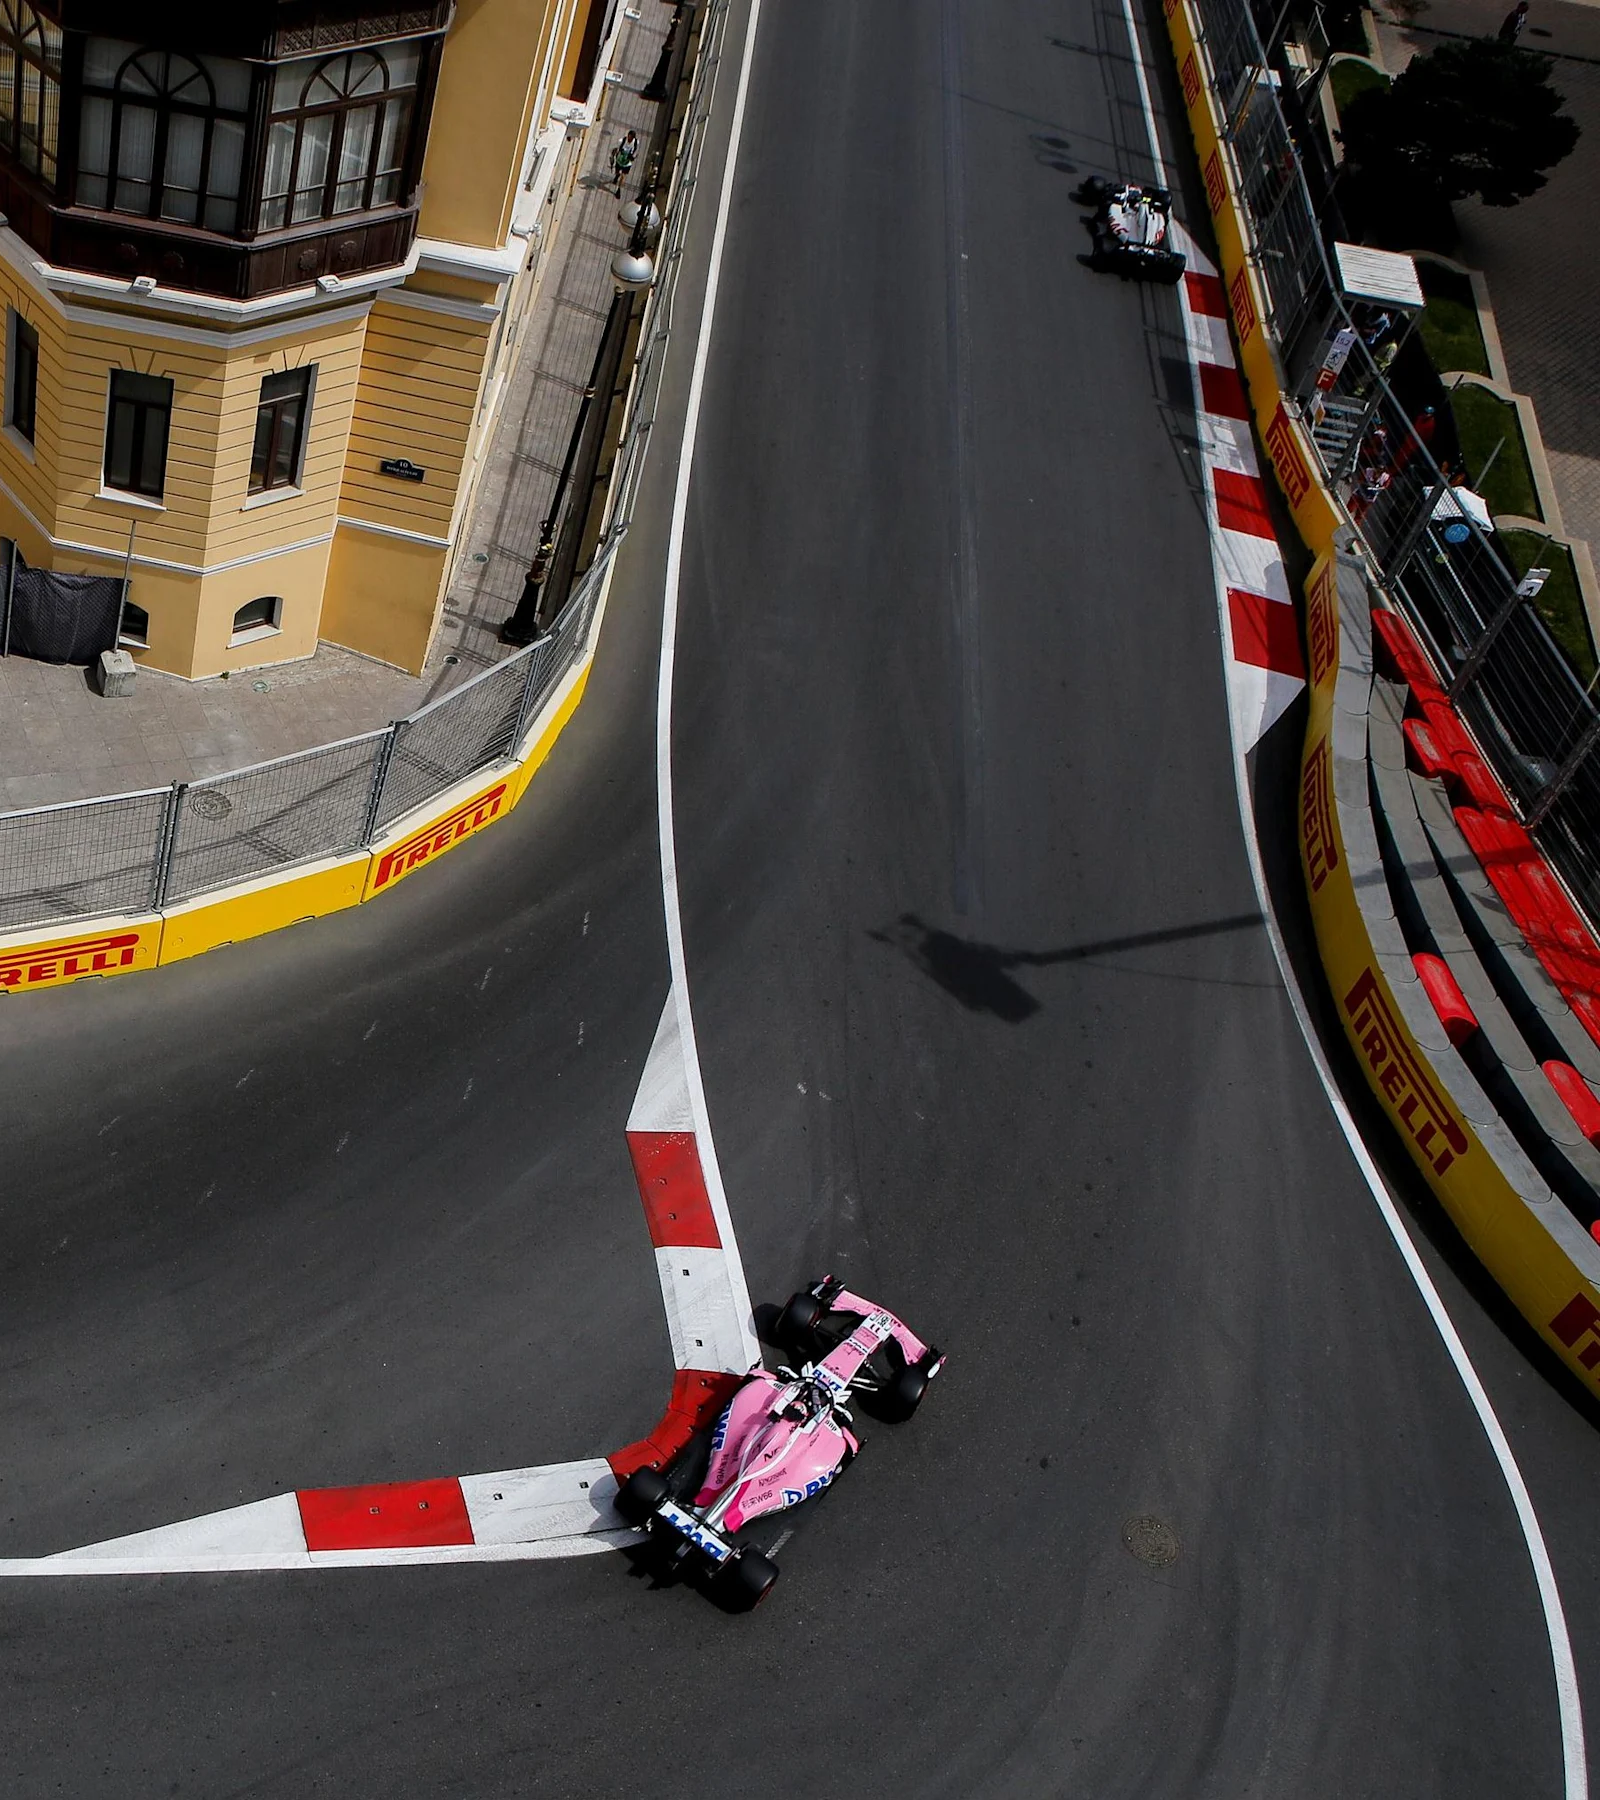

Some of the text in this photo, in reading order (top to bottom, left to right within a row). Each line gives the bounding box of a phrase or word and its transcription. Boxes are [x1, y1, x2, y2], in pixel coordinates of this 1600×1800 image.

[1265, 401, 1310, 510] PIRELLI
[1310, 562, 1336, 690] PIRELLI
[373, 783, 507, 889] PIRELLI
[1303, 733, 1338, 893] PIRELLI
[1343, 966, 1468, 1177] PIRELLI
